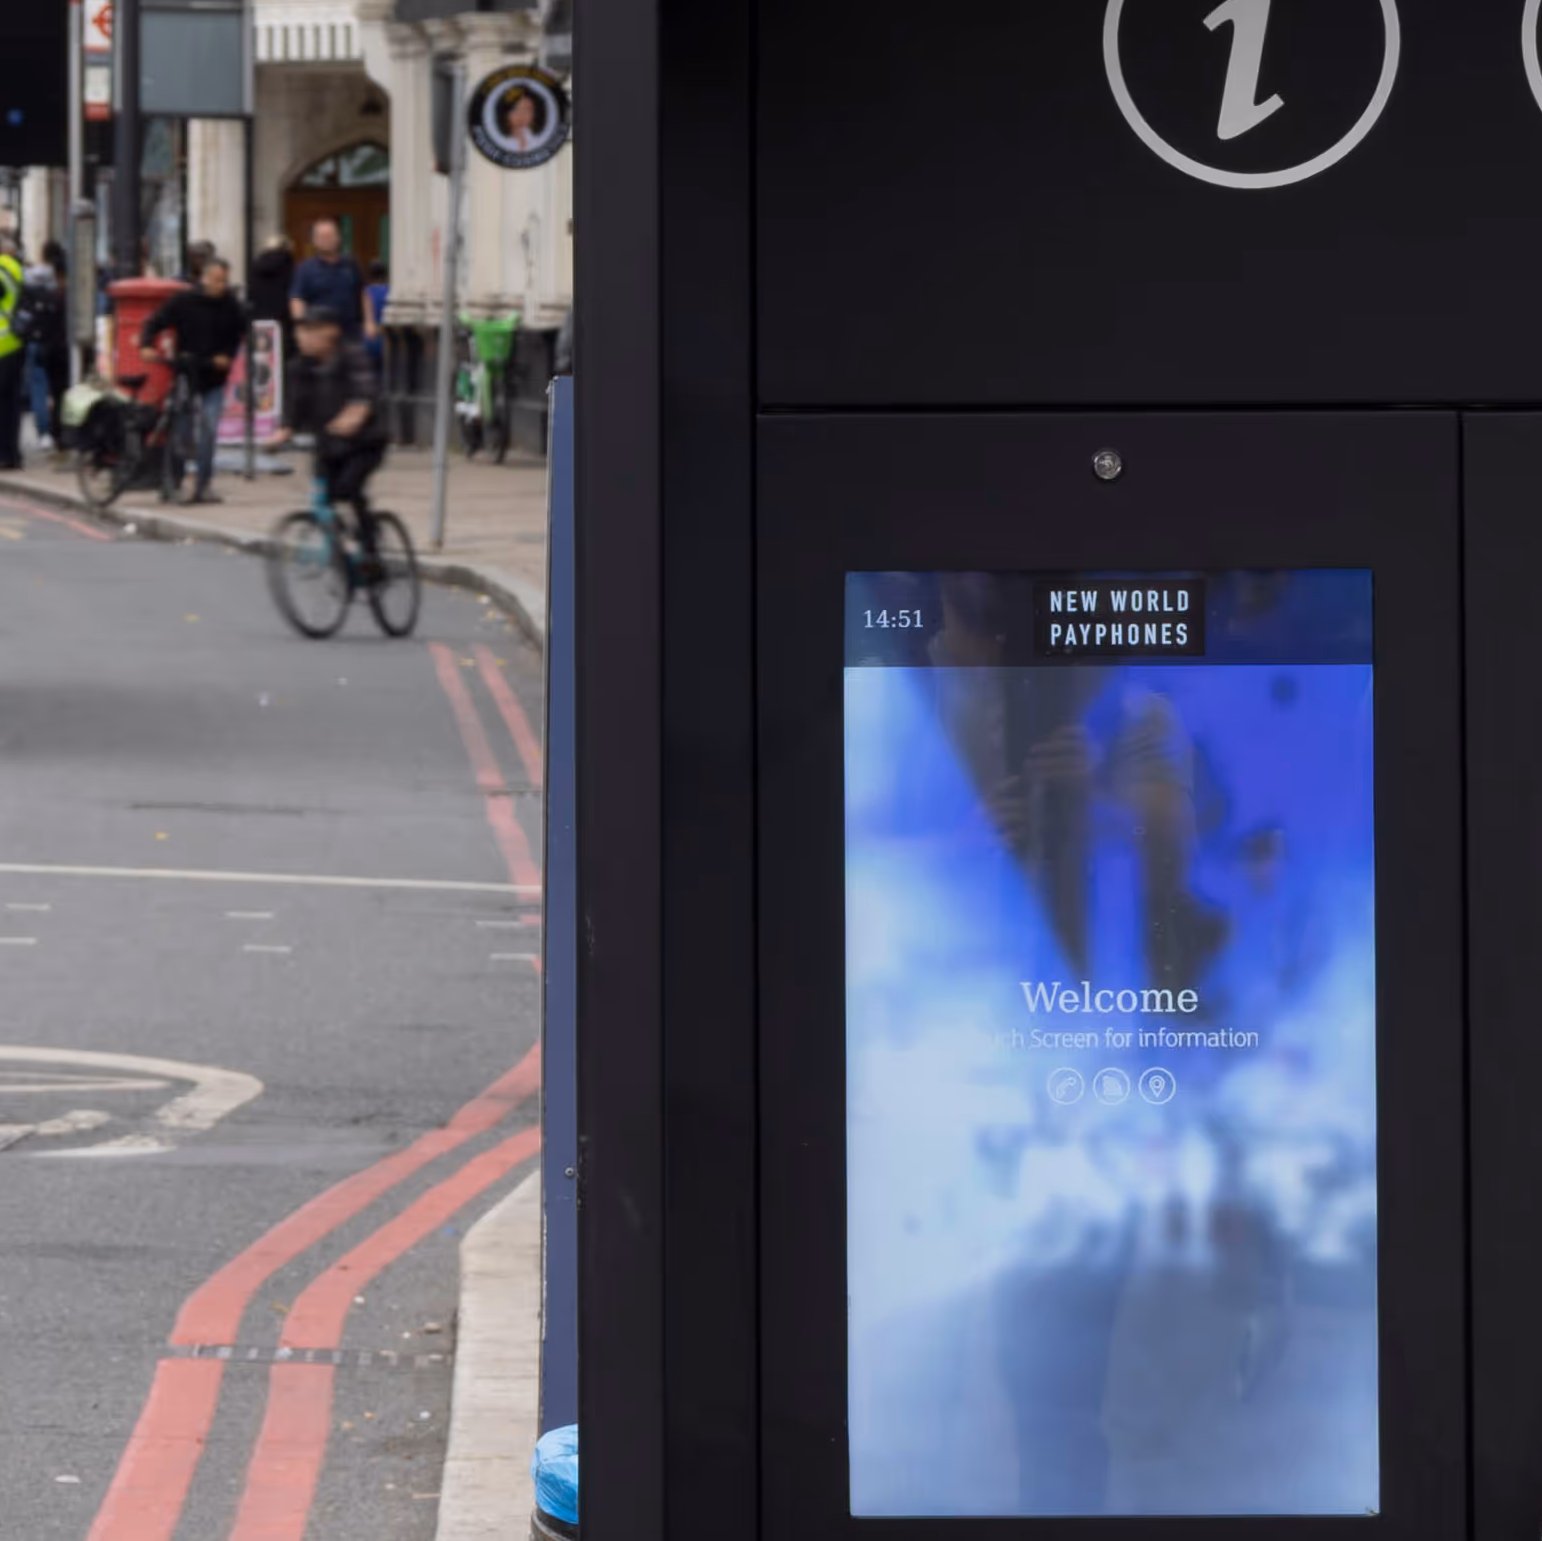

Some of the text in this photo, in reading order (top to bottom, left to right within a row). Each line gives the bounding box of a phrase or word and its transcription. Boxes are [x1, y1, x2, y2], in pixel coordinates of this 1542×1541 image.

[1049, 590, 1190, 612] NEW WORLD
[863, 608, 924, 629] 14:51
[1049, 622, 1189, 646] PAYPHONES
[1020, 980, 1199, 1014] Welcome
[1030, 1027, 1099, 1049] Screen
[1105, 1027, 1133, 1049] for
[1138, 1027, 1259, 1049] information
